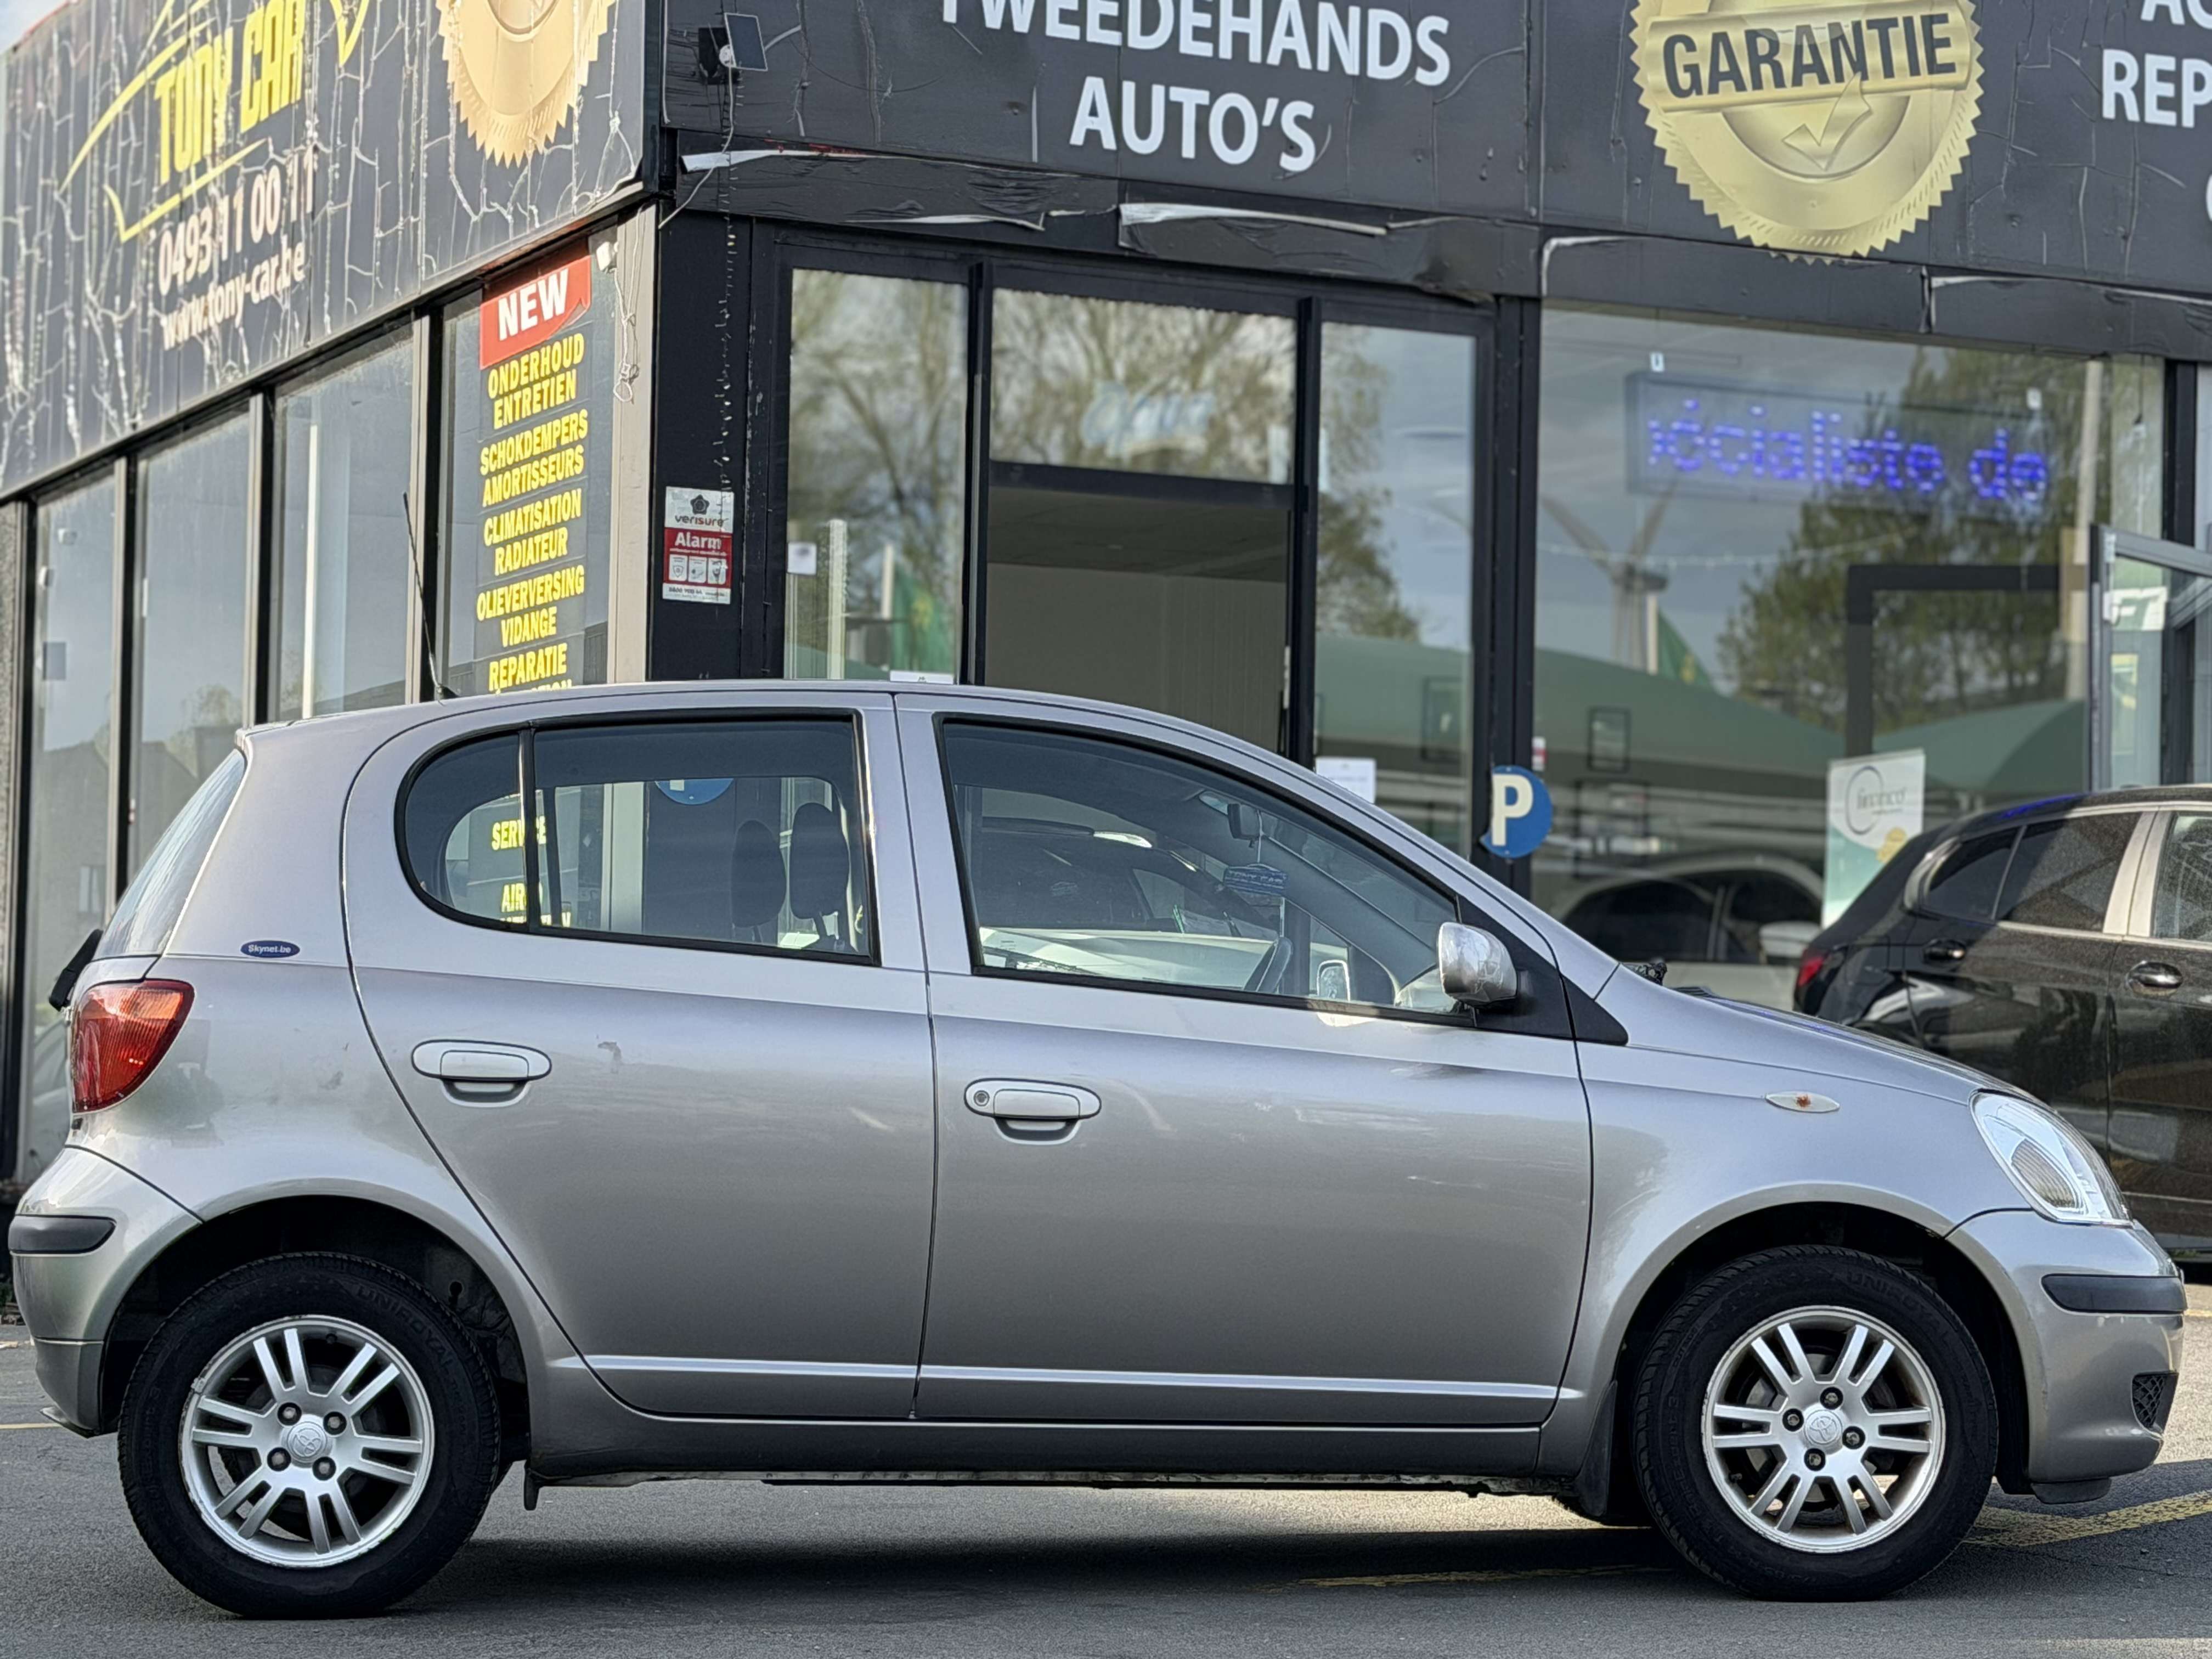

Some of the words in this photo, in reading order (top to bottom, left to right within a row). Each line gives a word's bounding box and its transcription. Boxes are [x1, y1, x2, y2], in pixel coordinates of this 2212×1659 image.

[1663, 13, 1956, 99] GARANTIE
[154, 26, 233, 185] TONY
[240, 0, 306, 133] CAR
[2102, 48, 2212, 128] REP
[1069, 76, 1315, 172] AUTO'S
[159, 205, 213, 296] 0493
[220, 189, 245, 261] 11
[250, 165, 281, 244] 00
[163, 241, 305, 351] www.tony-car.be
[498, 269, 568, 340] NEW
[488, 333, 584, 399] ONDERHOUD
[494, 369, 576, 430] ENTRETIEN
[481, 409, 588, 476] SCHOKDEMPERS
[1968, 428, 2047, 500] de
[483, 445, 584, 507] AMORTISSEURS
[484, 488, 582, 546] CLIMATISATION
[675, 515, 724, 527] verisure
[675, 532, 722, 550] Alarm
[495, 527, 568, 576] RADIATEUR
[477, 565, 585, 622] OLIEVERVERSING
[500, 607, 556, 648] VIDANGE
[489, 642, 567, 691] REPARATIE
[492, 815, 546, 850] SERVE
[1492, 774, 1533, 846] P
[501, 882, 543, 913] AIR
[248, 944, 291, 955] Skynet.be
